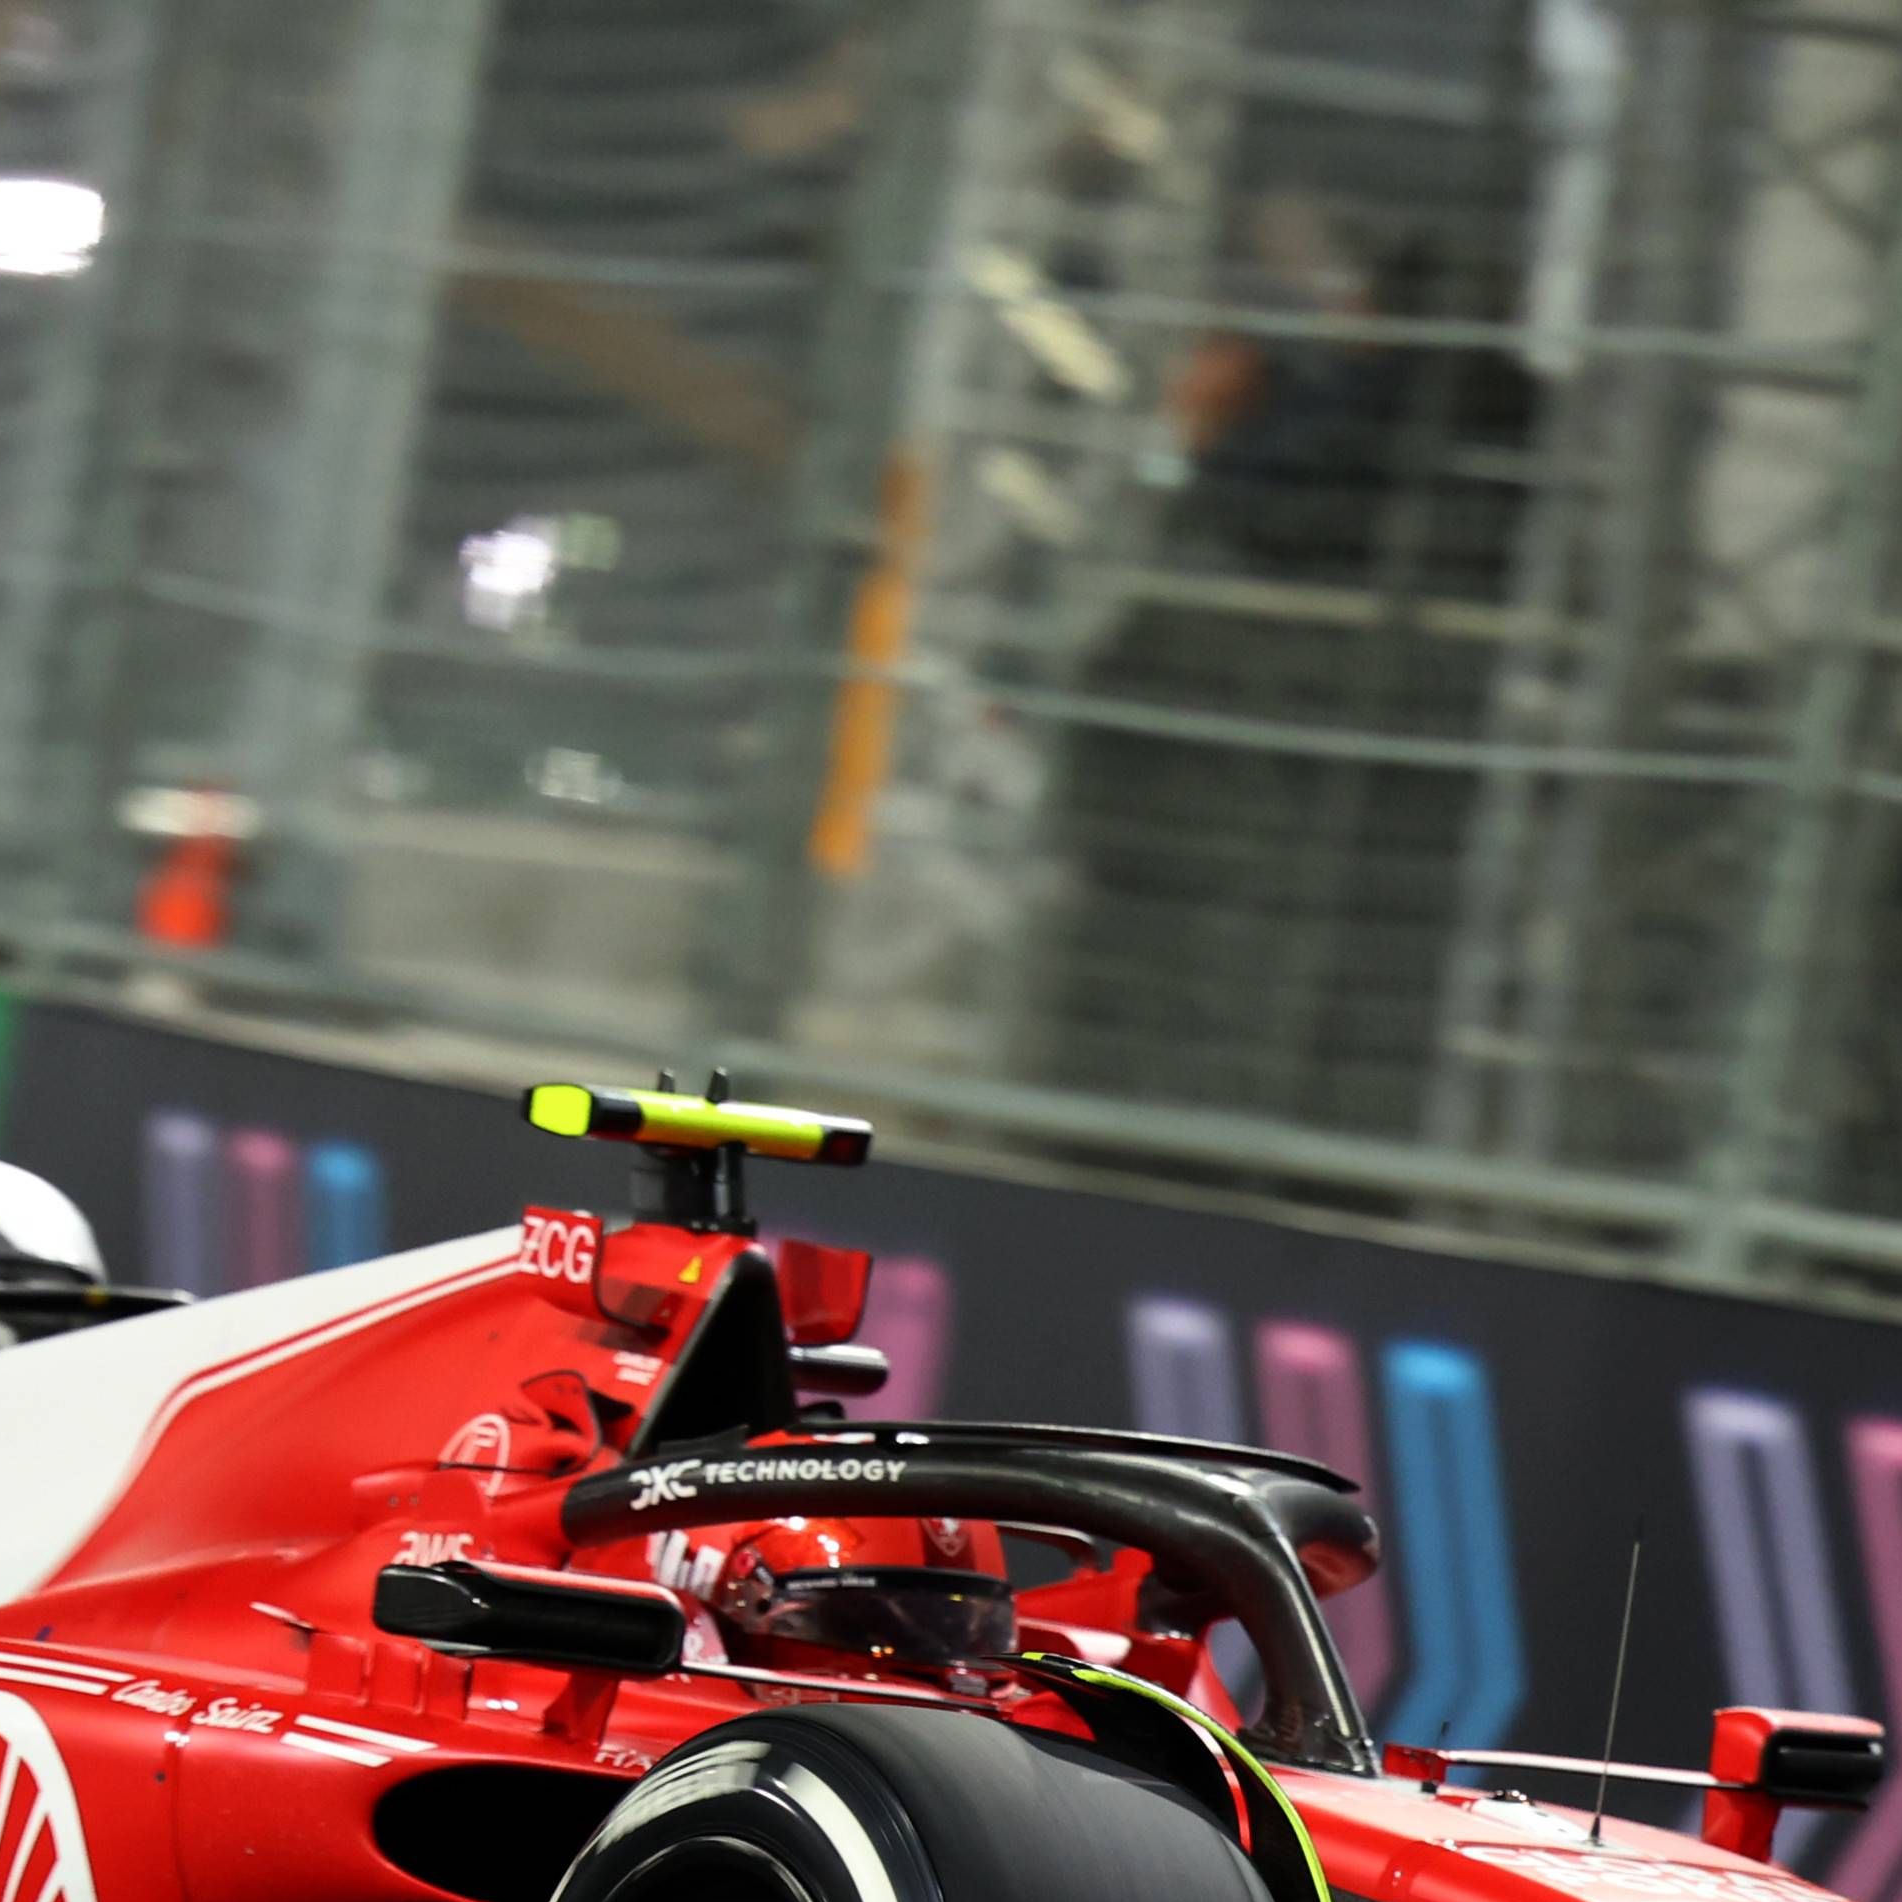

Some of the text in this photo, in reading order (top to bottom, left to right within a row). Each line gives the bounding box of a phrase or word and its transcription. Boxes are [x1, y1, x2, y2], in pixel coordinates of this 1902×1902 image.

[519, 1215, 597, 1284] ZCG
[703, 1458, 908, 1484] TECHNOLOGY
[190, 1697, 285, 1734] Sainz
